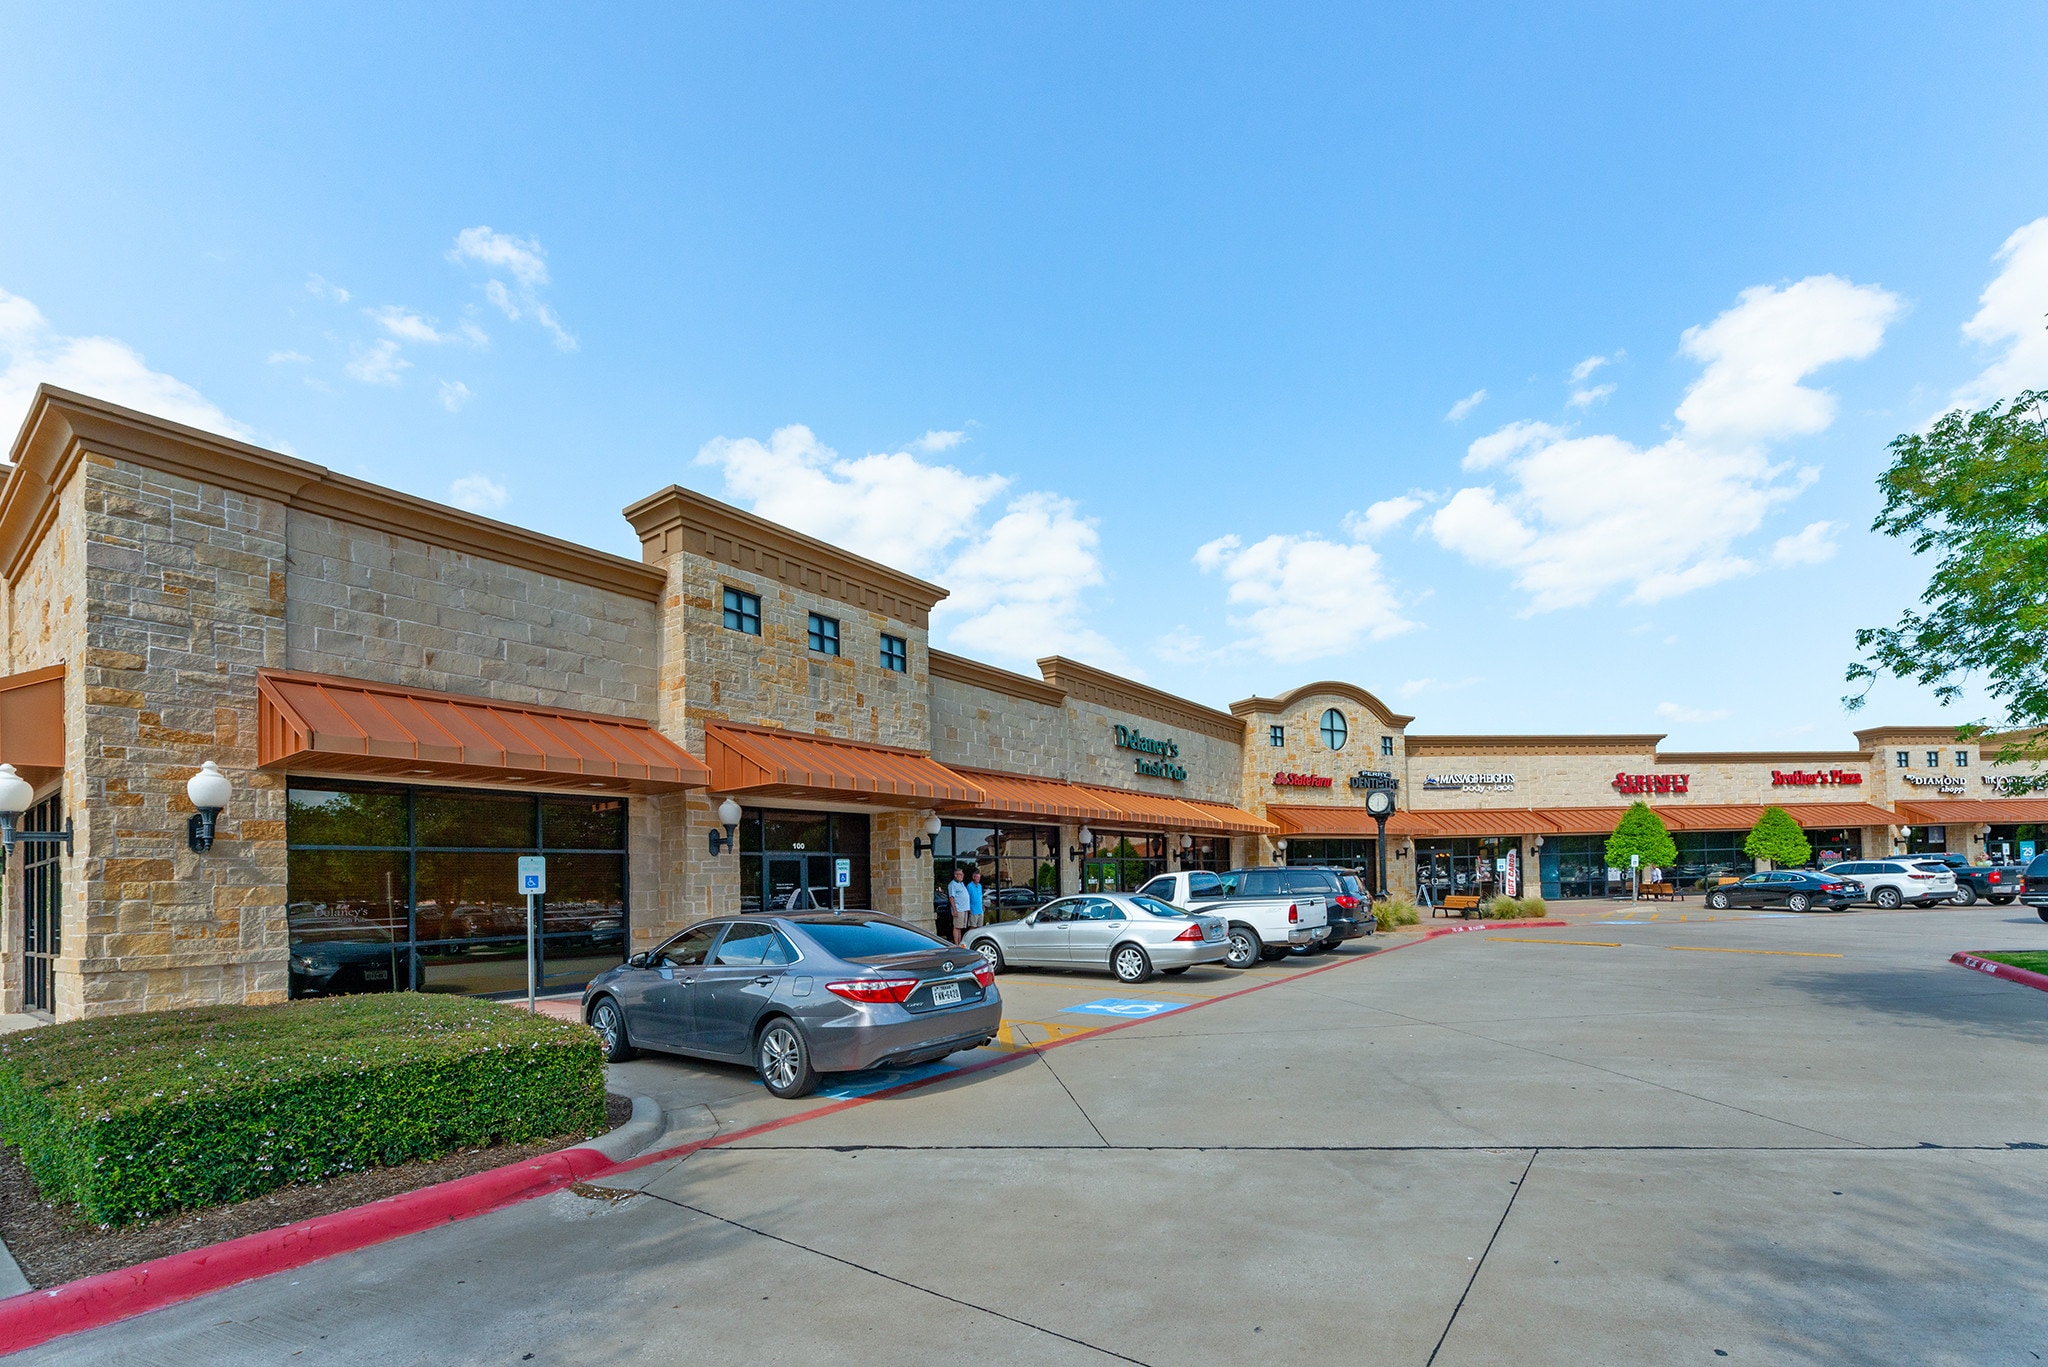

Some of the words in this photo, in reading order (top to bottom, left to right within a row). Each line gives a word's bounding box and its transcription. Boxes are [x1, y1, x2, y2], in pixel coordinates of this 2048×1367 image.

[1114, 724, 1179, 762] Delaney's
[1134, 758, 1165, 776] Irish
[1165, 763, 1188, 780] Pub
[1439, 774, 1479, 783] MASSAGE
[1479, 774, 1515, 783] HEIGHTS
[1612, 772, 1690, 786] SERENITY
[1772, 770, 1829, 785] Brother's
[1830, 770, 1863, 785] Pizza
[1914, 775, 1967, 785] DIAMOND
[1462, 784, 1484, 792] body
[1507, 879, 1515, 895] GIFT
